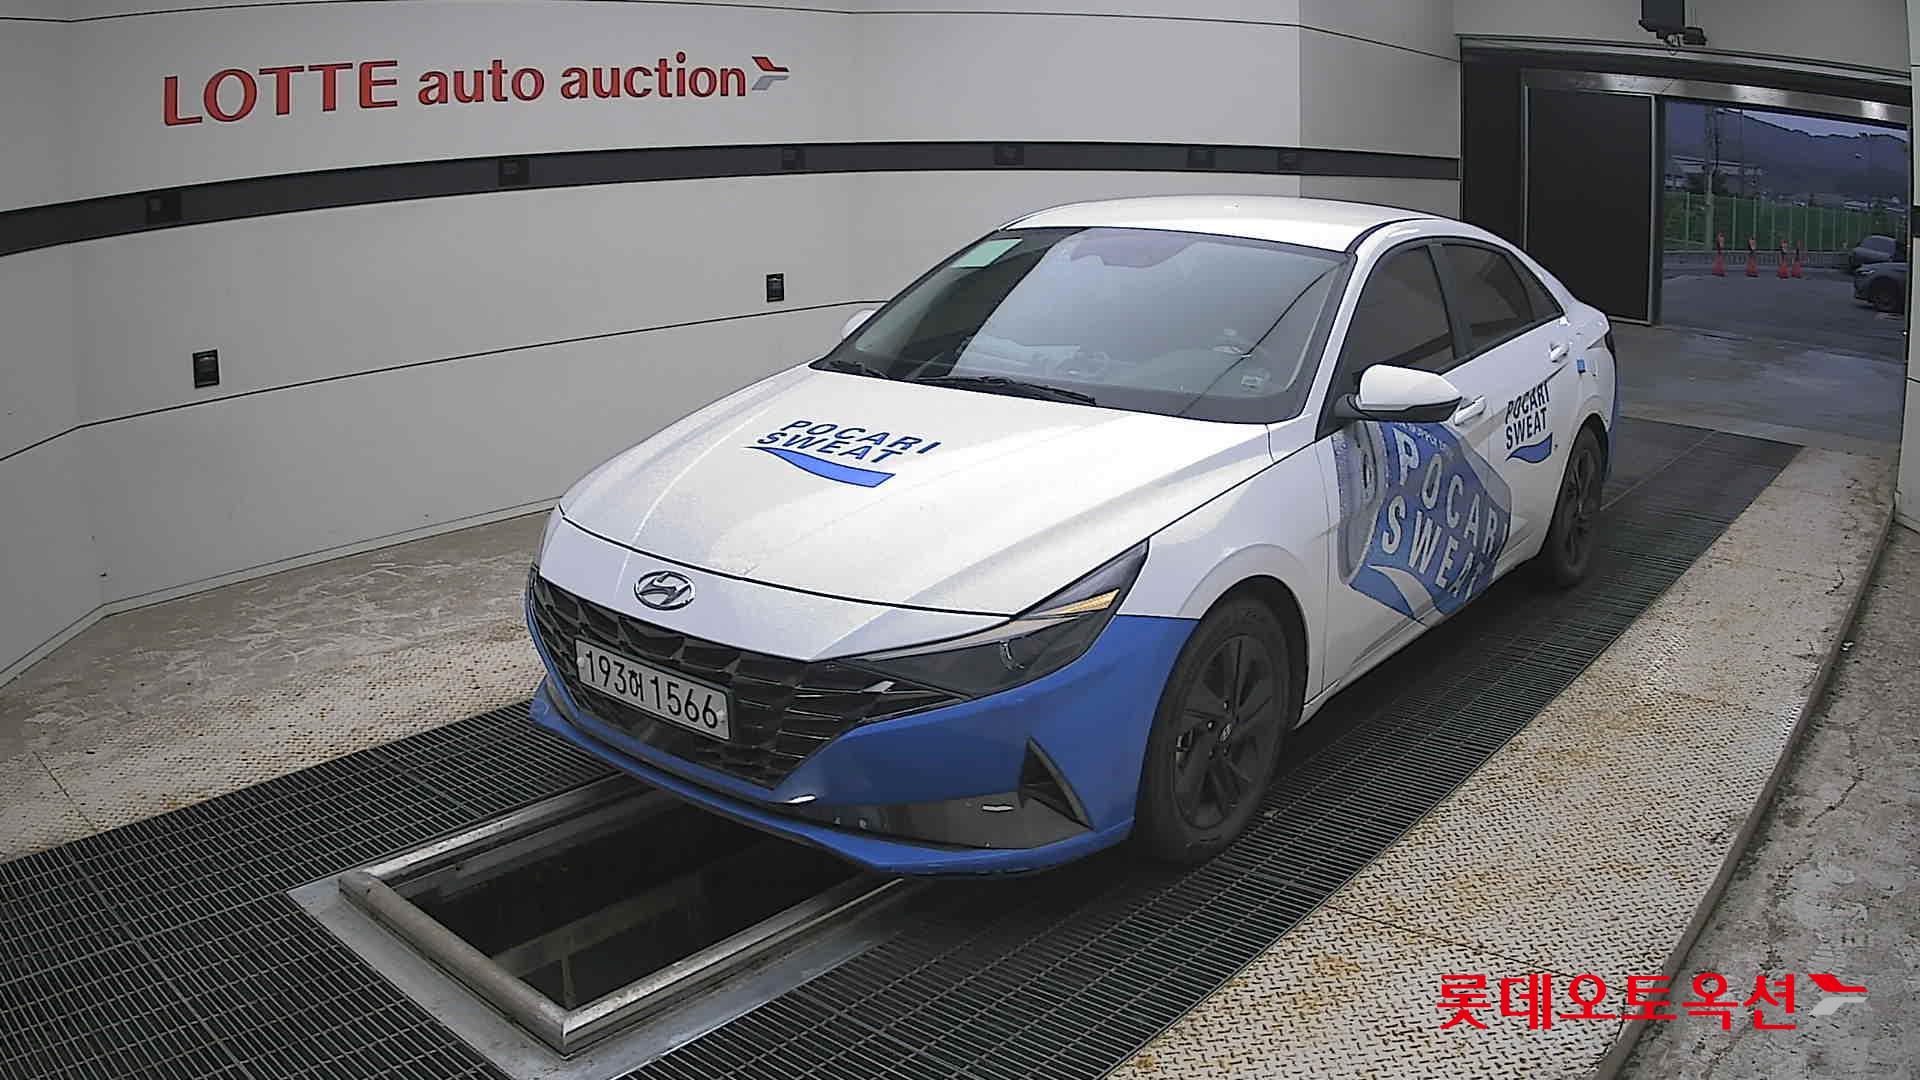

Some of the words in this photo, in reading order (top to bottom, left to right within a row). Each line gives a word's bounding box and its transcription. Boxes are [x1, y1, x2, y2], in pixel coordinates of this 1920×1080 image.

[164, 60, 398, 126] LOTTE
[417, 59, 545, 105] auto
[560, 51, 746, 99] auction
[1505, 380, 1550, 424] POCARI
[757, 432, 902, 463] SWEAT
[780, 420, 941, 454] POCARI
[1506, 407, 1546, 450] SWEAT
[650, 675, 718, 729] 1566
